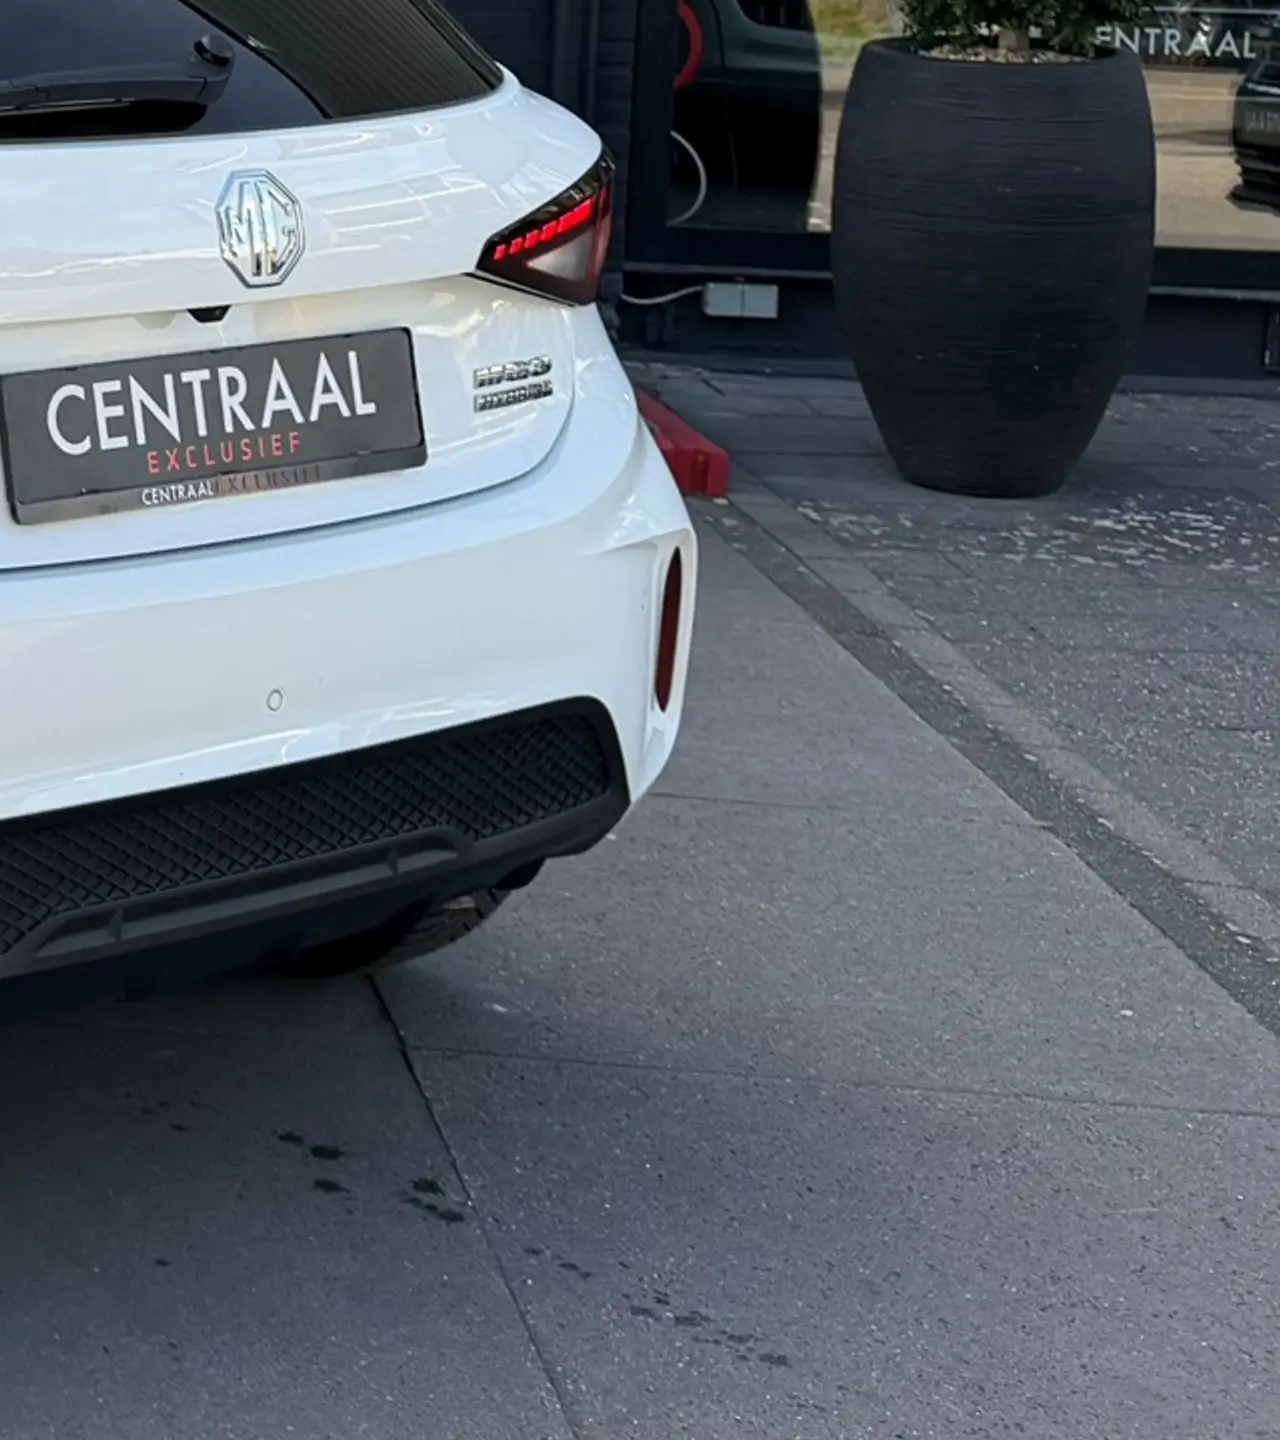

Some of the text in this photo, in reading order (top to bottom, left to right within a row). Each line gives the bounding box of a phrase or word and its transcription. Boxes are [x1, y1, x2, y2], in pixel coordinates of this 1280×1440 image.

[1095, 25, 1257, 59] ENTRAAL
[218, 174, 300, 282] MG
[46, 350, 377, 456] CENTRAAL
[147, 431, 301, 474] EXCLUSIEF
[141, 482, 214, 506] CENTRAAL
